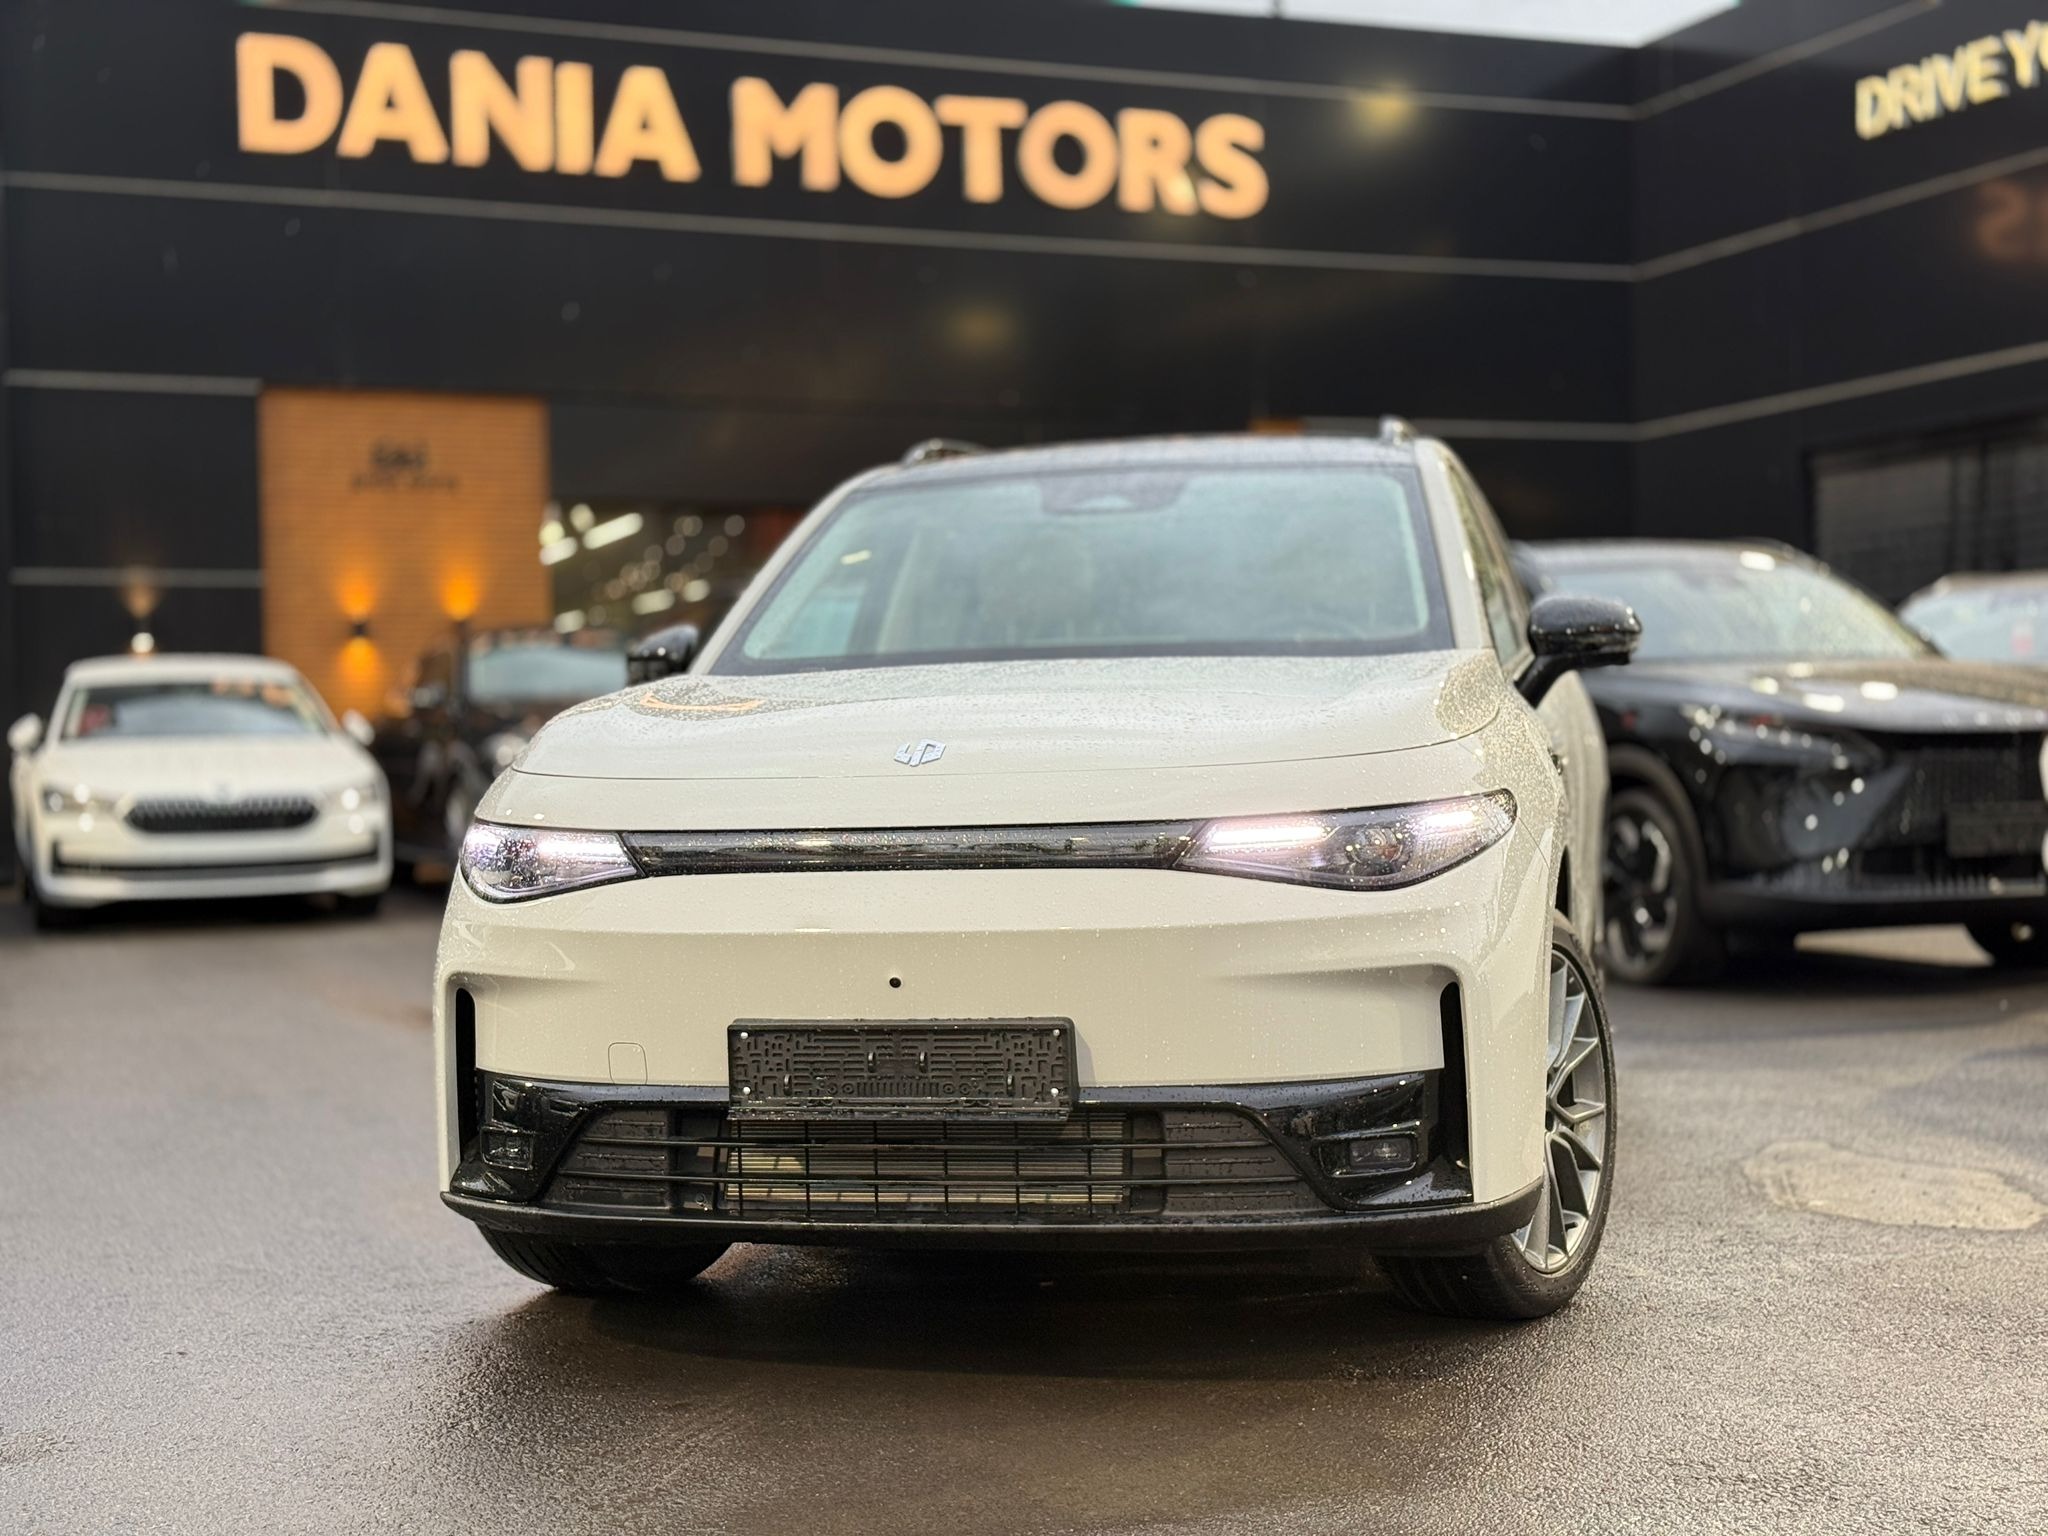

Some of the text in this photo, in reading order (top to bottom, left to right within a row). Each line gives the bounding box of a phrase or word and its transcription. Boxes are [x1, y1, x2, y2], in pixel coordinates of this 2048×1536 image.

[236, 32, 1269, 219] DANIA MOTORS
[1856, 35, 2008, 140] DRIVE
